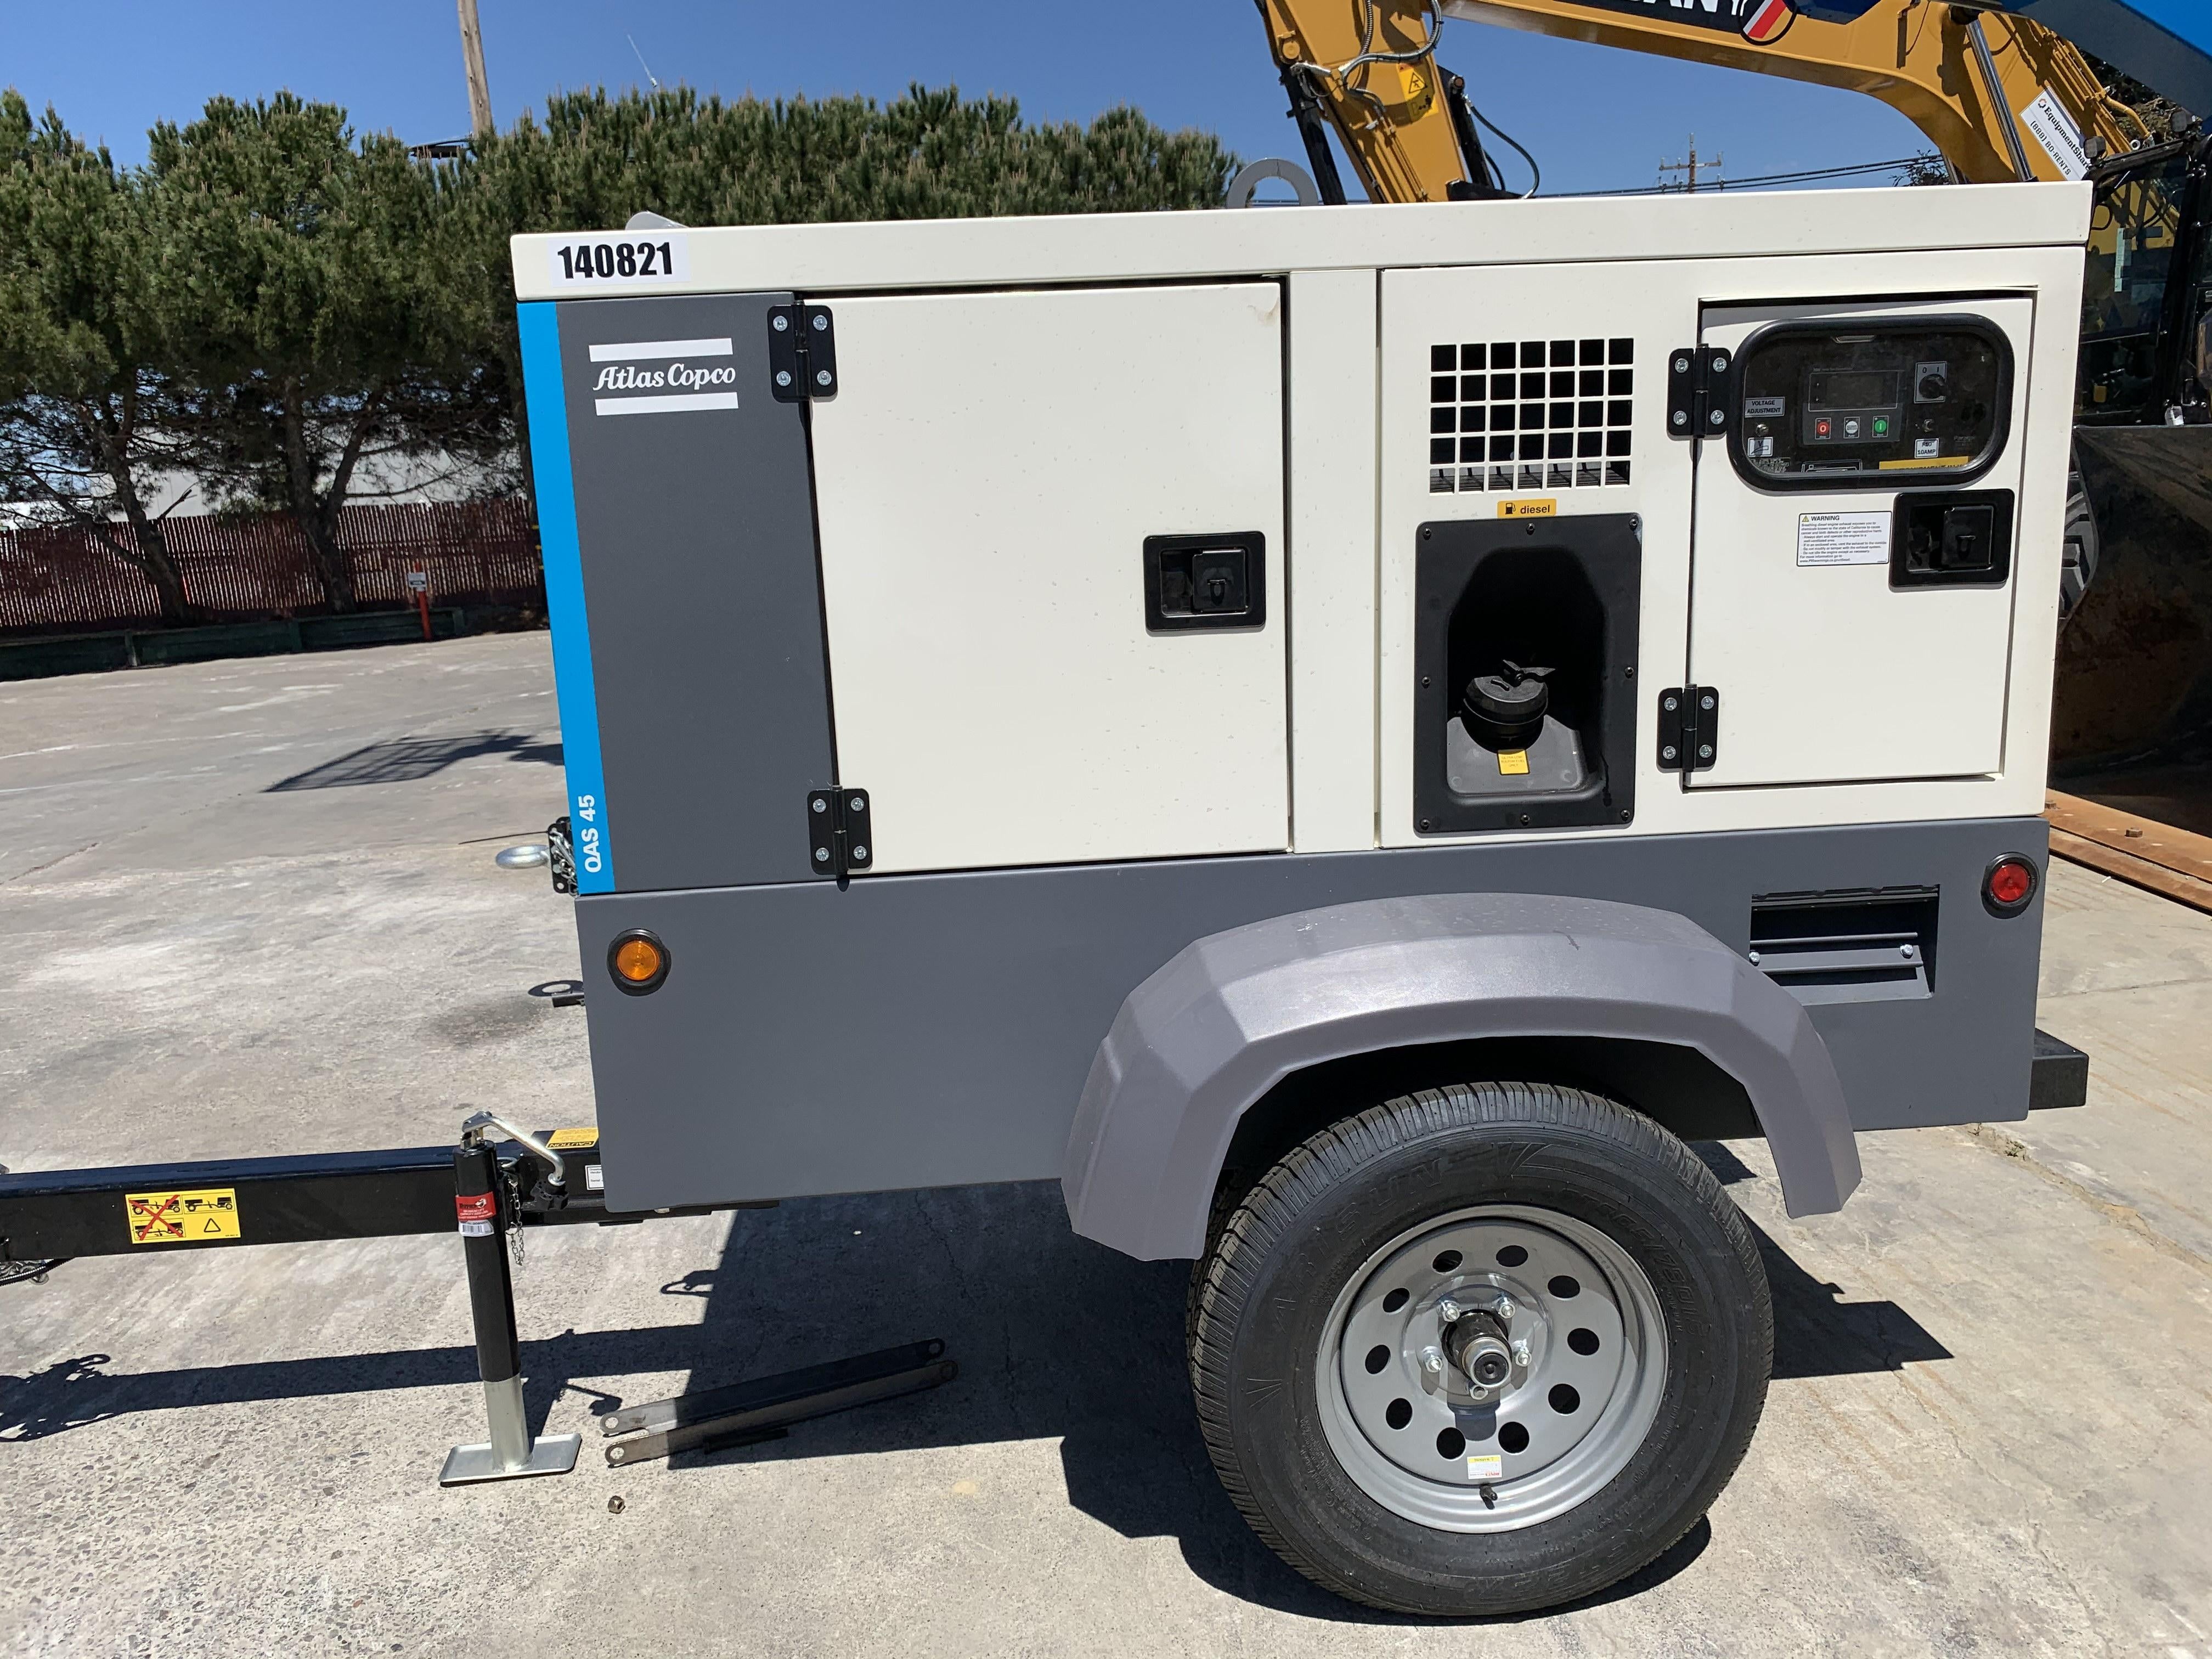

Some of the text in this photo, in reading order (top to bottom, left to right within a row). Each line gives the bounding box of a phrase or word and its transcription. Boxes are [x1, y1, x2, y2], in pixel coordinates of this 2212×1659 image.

[2030, 120, 2071, 175] (888) 80-RENTS
[557, 242, 673, 279] 140821
[592, 363, 736, 391] Atlas Copco
[1520, 505, 1550, 514] diesel
[578, 794, 602, 873] QAS 45
